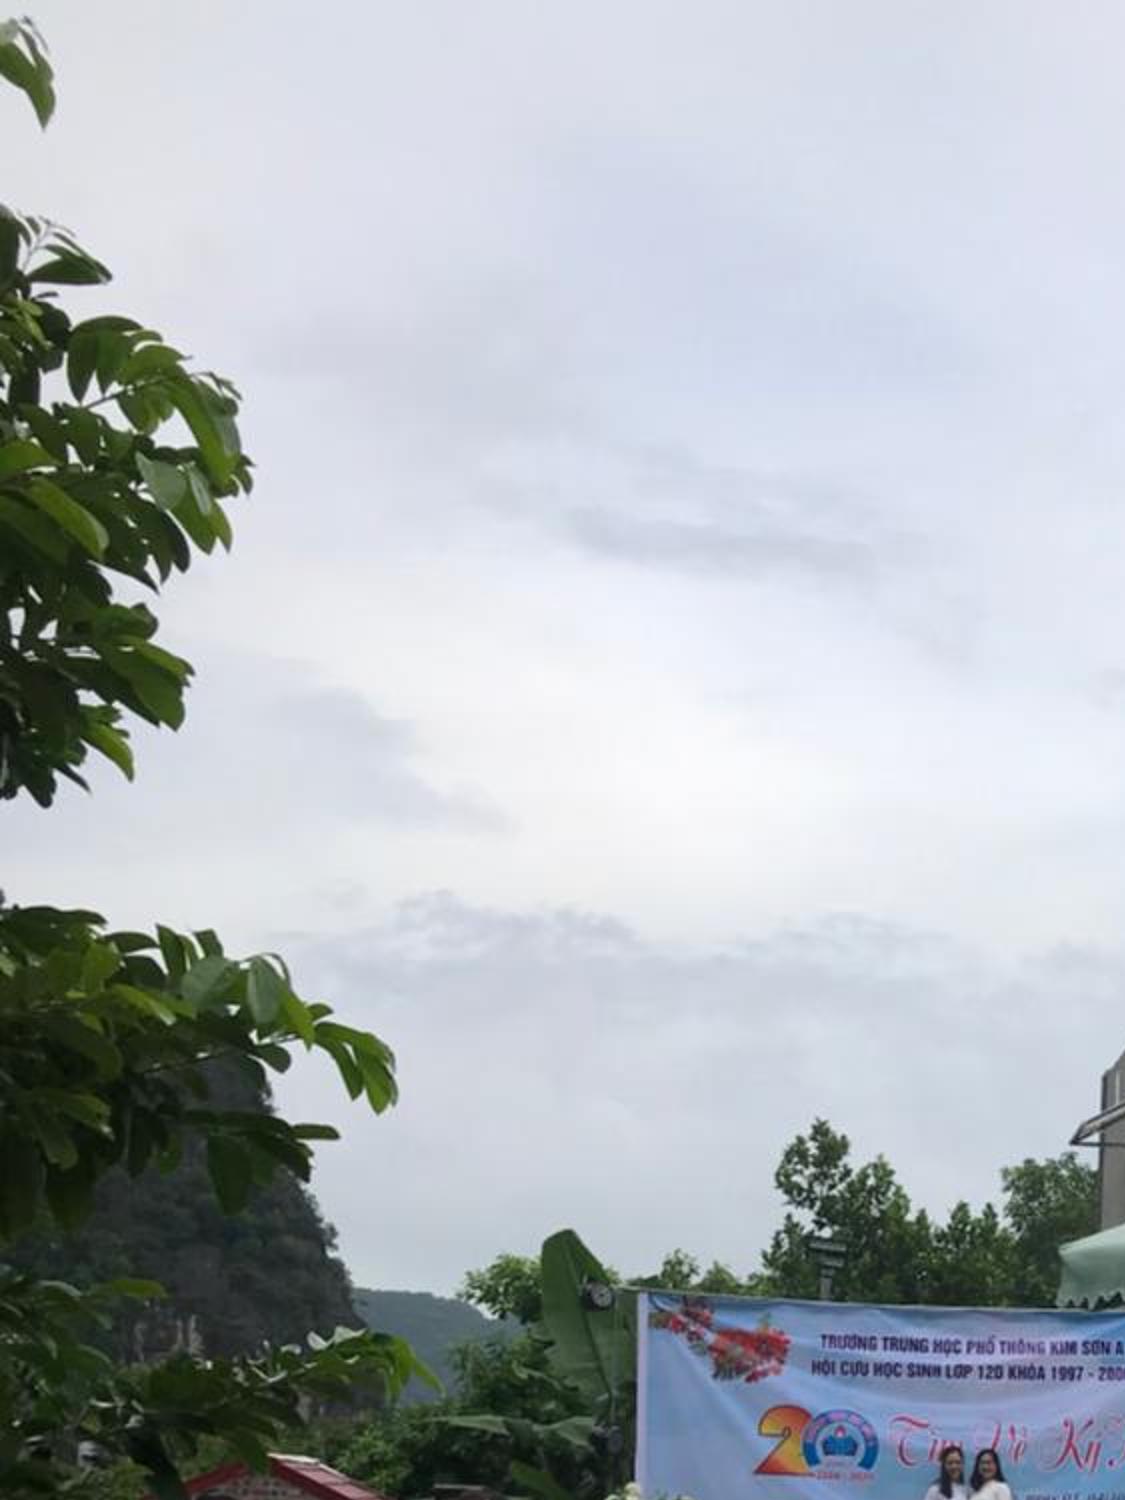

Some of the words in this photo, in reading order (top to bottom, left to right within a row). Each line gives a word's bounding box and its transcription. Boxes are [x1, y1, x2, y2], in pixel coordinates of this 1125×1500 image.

[881, 1336, 929, 1353] TRUNG
[1050, 1339, 1077, 1355] KIM
[1115, 1339, 1125, 1355] A
[906, 1362, 941, 1379] SINH
[1051, 1366, 1084, 1381] 1997
